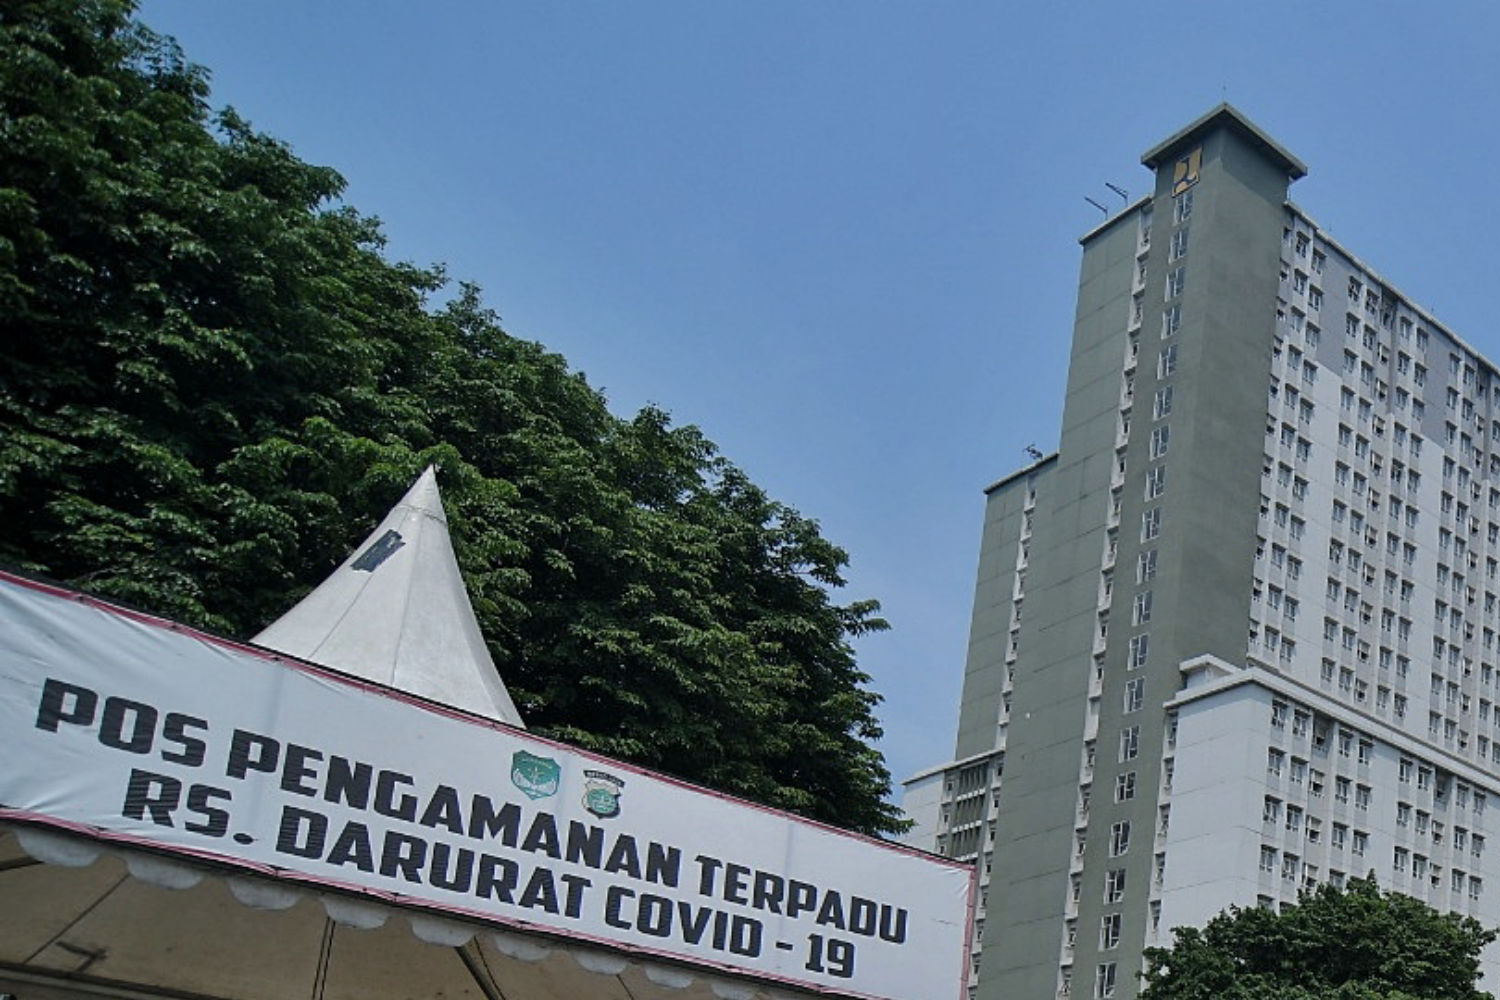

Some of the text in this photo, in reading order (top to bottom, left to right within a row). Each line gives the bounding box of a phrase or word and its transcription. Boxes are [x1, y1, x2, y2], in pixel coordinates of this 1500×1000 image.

[35, 677, 908, 945] POS PENGAMANAN TERPADU
[122, 767, 255, 846] RS.
[276, 804, 593, 920] DARURAT
[604, 885, 764, 958] COVID
[804, 933, 855, 979] 19
